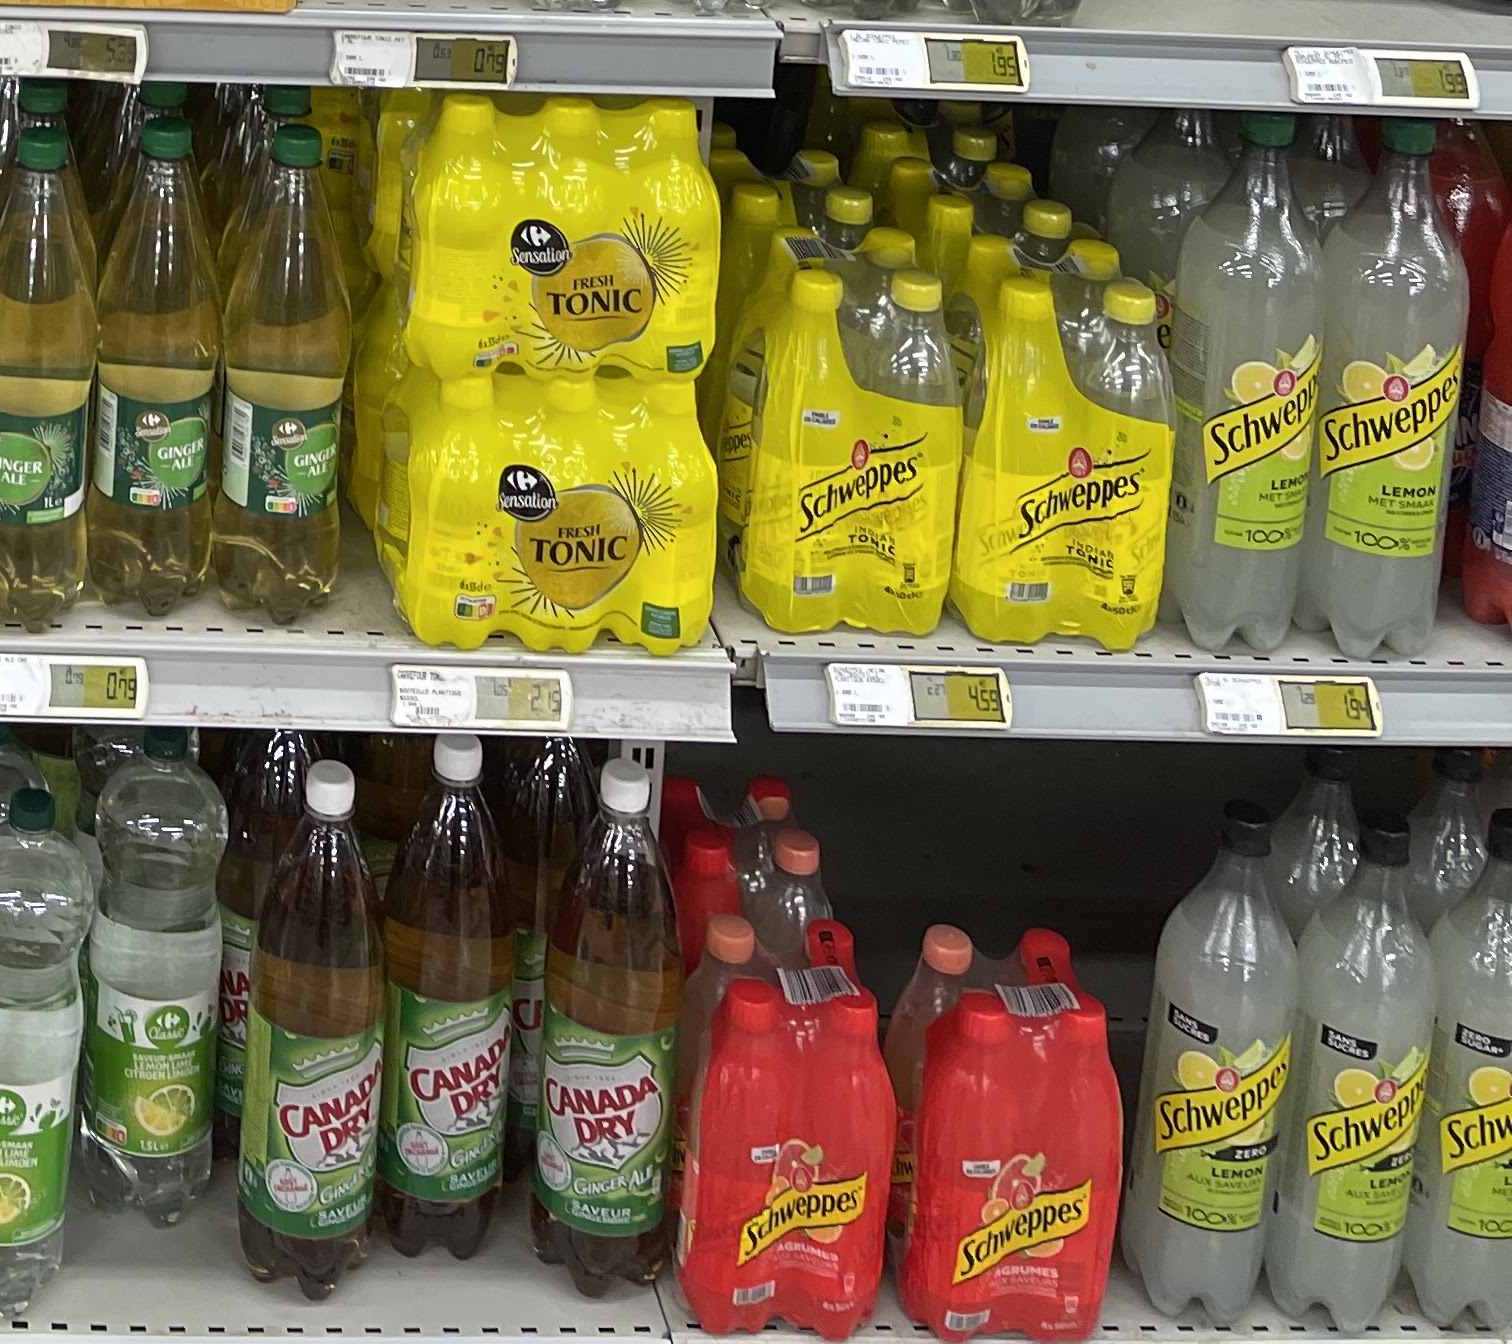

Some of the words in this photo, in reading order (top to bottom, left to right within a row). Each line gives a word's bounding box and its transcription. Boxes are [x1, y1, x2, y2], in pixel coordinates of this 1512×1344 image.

[511, 245, 571, 265] Sensation
[573, 276, 614, 290] FRESH
[546, 289, 642, 317] TONIC
[1, 472, 27, 485] ALE
[799, 455, 918, 530] Schweppes
[1368, 496, 1395, 506] MET
[1381, 484, 1437, 498] LEMON
[848, 534, 895, 556] TONIC
[547, 1077, 659, 1114] CANADA
[573, 1111, 637, 1146] DRY
[1234, 1143, 1267, 1159] ZERO
[1210, 1167, 1264, 1180] LEMON
[573, 1177, 623, 1195] GINGER
[744, 1186, 860, 1258] Schweppes
[961, 1199, 1084, 1276] Schweppes
